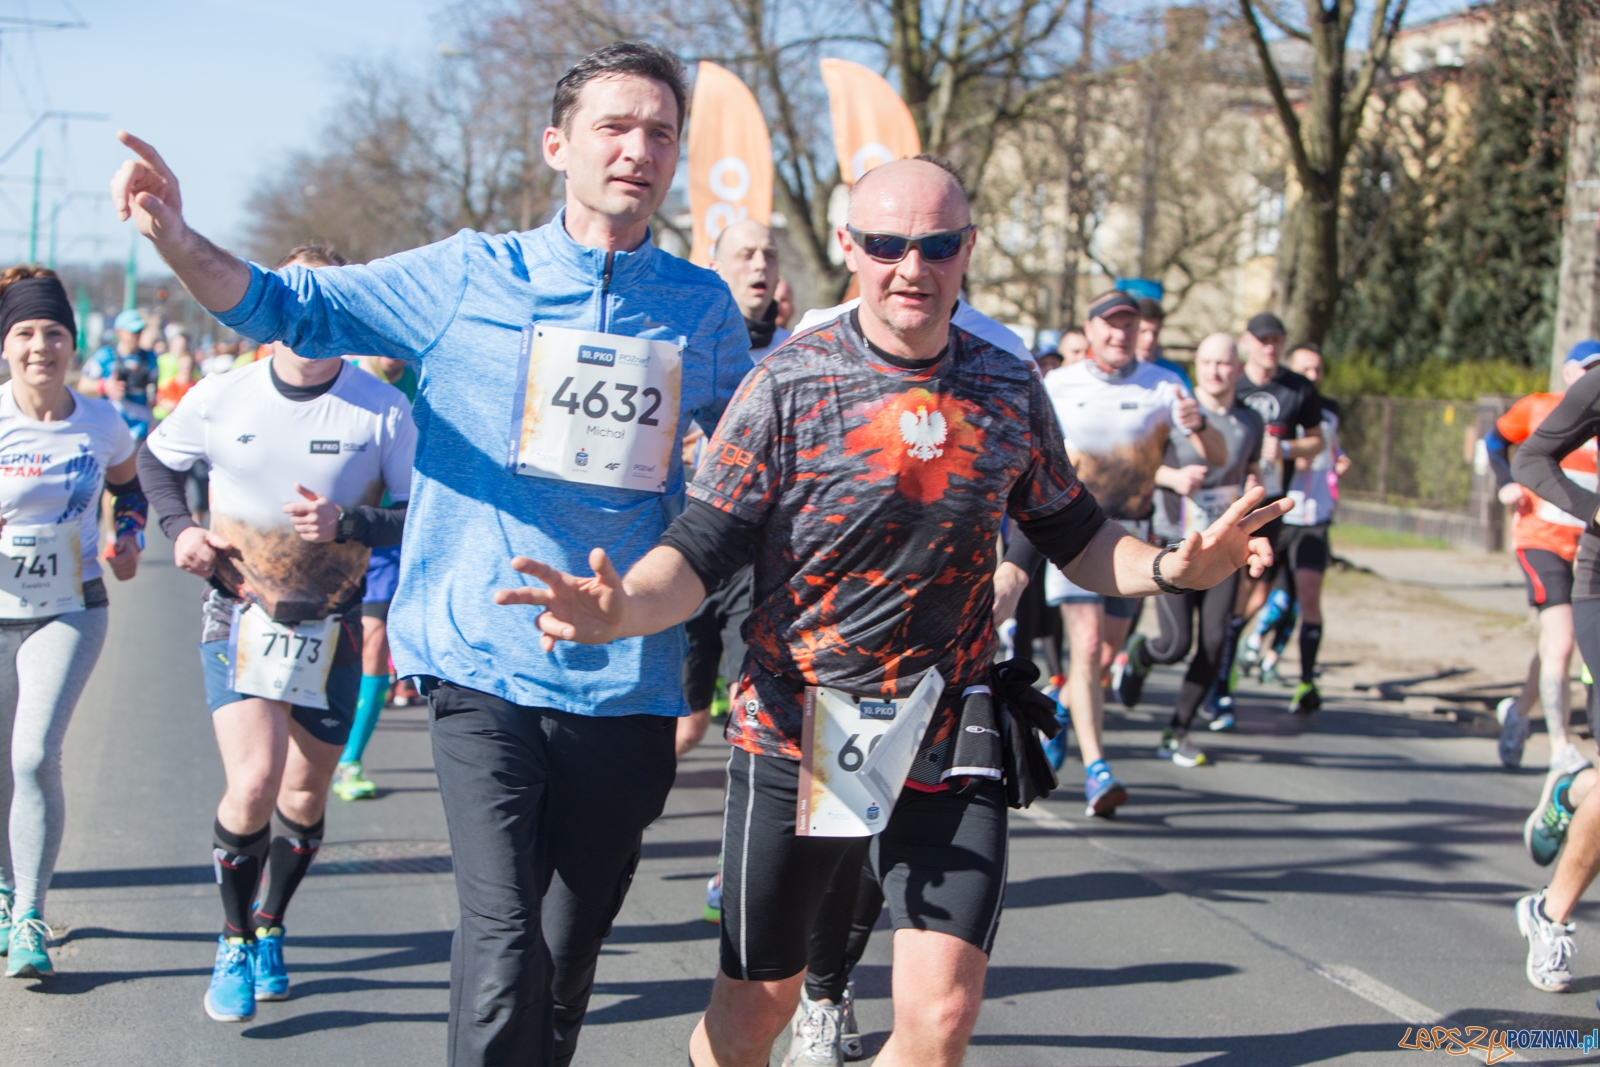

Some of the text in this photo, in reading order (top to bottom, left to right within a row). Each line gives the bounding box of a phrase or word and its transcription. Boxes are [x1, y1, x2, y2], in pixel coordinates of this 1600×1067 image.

[551, 376, 662, 427] 4632
[236, 434, 256, 444] 4F
[586, 424, 626, 439] Michał
[0, 466, 42, 478] EAM
[11, 553, 58, 579] 741
[262, 632, 322, 664] 7173
